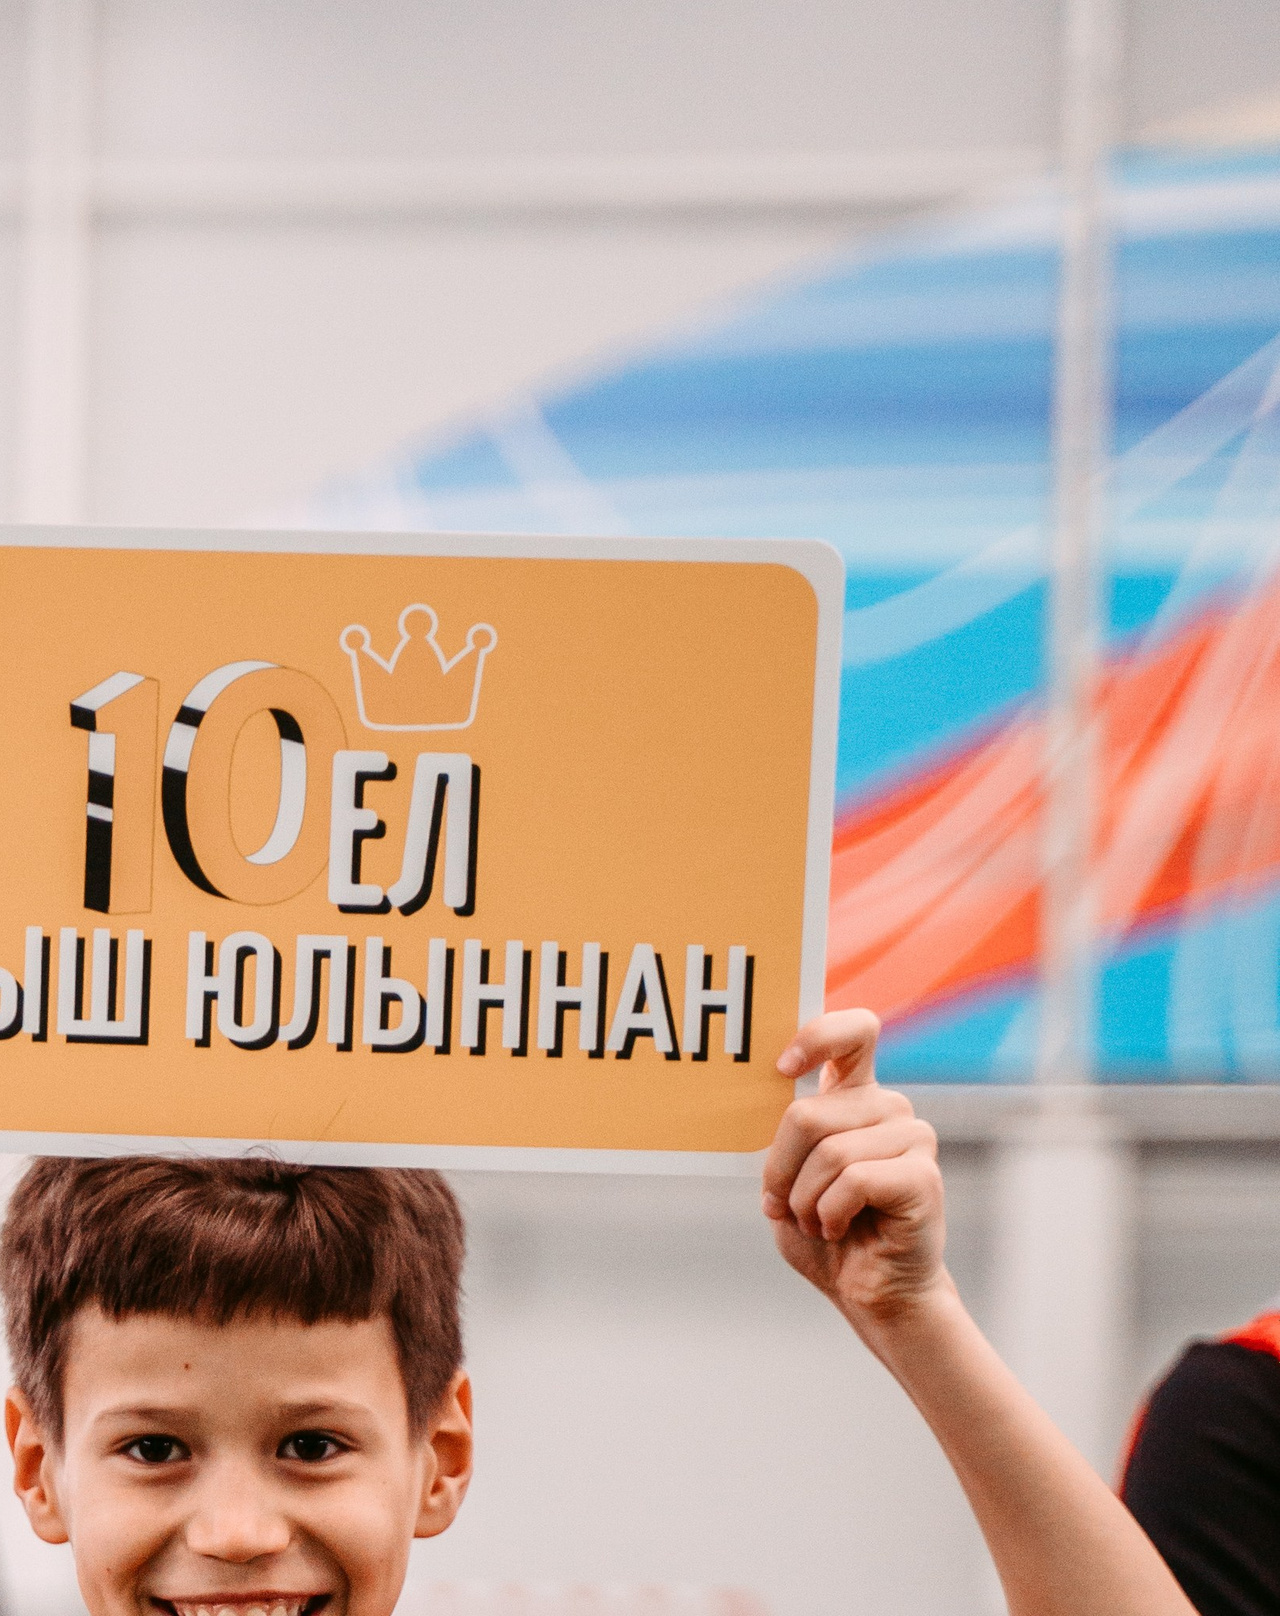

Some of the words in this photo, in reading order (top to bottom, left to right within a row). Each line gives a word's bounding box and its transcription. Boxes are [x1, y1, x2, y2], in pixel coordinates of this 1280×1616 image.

[68, 658, 348, 916] 10
[328, 749, 482, 916] ЕЛ
[184, 930, 756, 1063] ЮЛЫННАН
